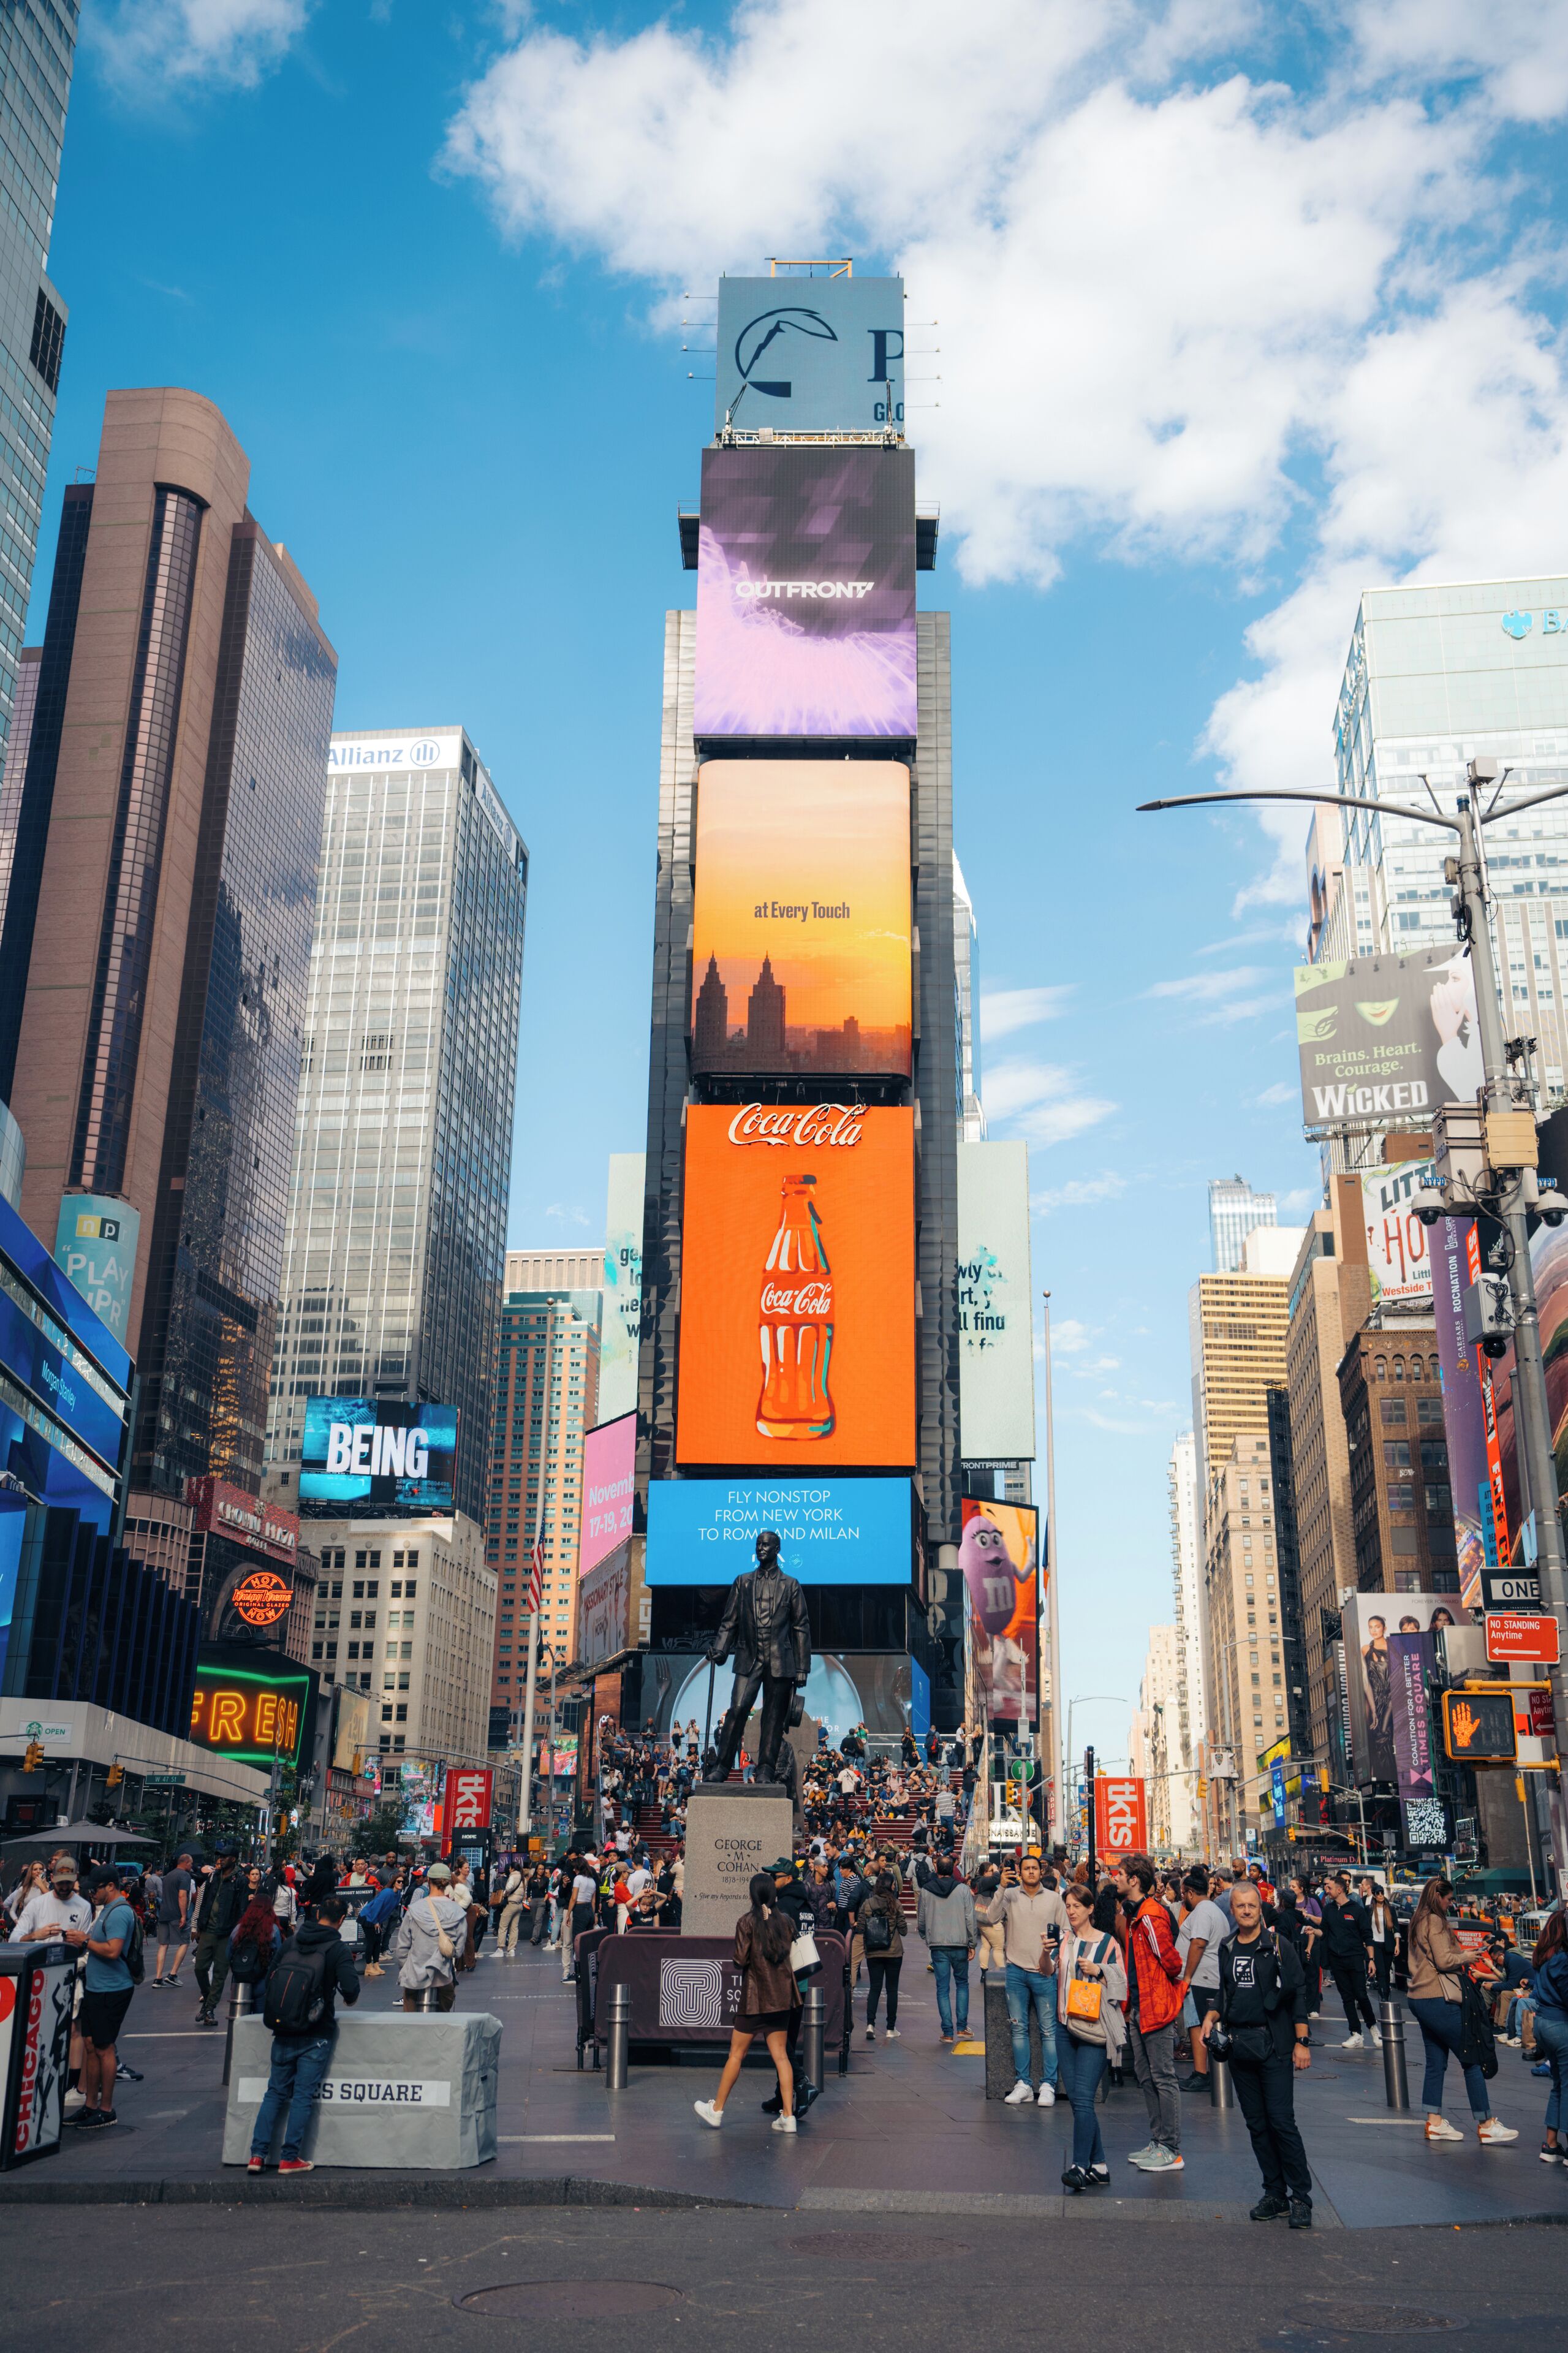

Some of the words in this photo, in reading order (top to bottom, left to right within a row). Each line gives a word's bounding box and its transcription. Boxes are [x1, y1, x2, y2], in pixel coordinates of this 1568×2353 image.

[735, 582, 874, 598] OUTFRONT
[328, 747, 403, 765] Allianz
[754, 903, 768, 919] at
[771, 902, 808, 922] Every
[811, 902, 850, 919] Touch
[1314, 1050, 1369, 1066] Brains.
[1373, 1042, 1422, 1059] Heart.
[1335, 1060, 1403, 1077] Courage.
[728, 1102, 871, 1146] Coca-Cola
[1423, 1177, 1445, 1186] NYPD
[83, 1219, 127, 1241] npr
[760, 1282, 831, 1315] Coca-Cola
[1382, 1284, 1425, 1296] Westside
[1455, 1320, 1464, 1358] CAESARS
[42, 1360, 60, 1392] Morgan
[59, 1380, 76, 1412] Stanley
[327, 1422, 428, 1479] BEING
[729, 1491, 752, 1504] FLY
[756, 1490, 831, 1503] NONSTOP
[716, 1509, 759, 1522] FROM
[763, 1509, 798, 1522] NEW
[803, 1509, 843, 1521] YORK
[699, 1528, 719, 1540] TO
[775, 1528, 805, 1540] AND
[809, 1526, 859, 1540] MILAN
[251, 1576, 278, 1588] HOT
[1502, 1582, 1540, 1598] ONE
[232, 1589, 264, 1602] Krispy
[262, 1589, 294, 1602] Kreme
[982, 1576, 1014, 1614] m
[246, 1608, 276, 1621] NOW
[1490, 1620, 1501, 1629] NO
[1504, 1620, 1540, 1630] STANDING
[1491, 1630, 1523, 1641] Anytime
[1403, 1655, 1412, 1688] BETTER
[1411, 1653, 1424, 1713] SQUARE
[1532, 1696, 1540, 1704] NO
[1409, 1718, 1418, 1765] COALITION
[1417, 1720, 1429, 1765] TIMES
[455, 1774, 485, 1828] tkts
[1108, 1782, 1138, 1847] tkts
[714, 1839, 762, 1851] GEORGE
[733, 1851, 744, 1861] M
[717, 1861, 759, 1873] COHAN
[720, 1893, 741, 1901] Regards
[15, 1969, 45, 2152] CHICAGO
[340, 2083, 423, 2102] SQUARE
